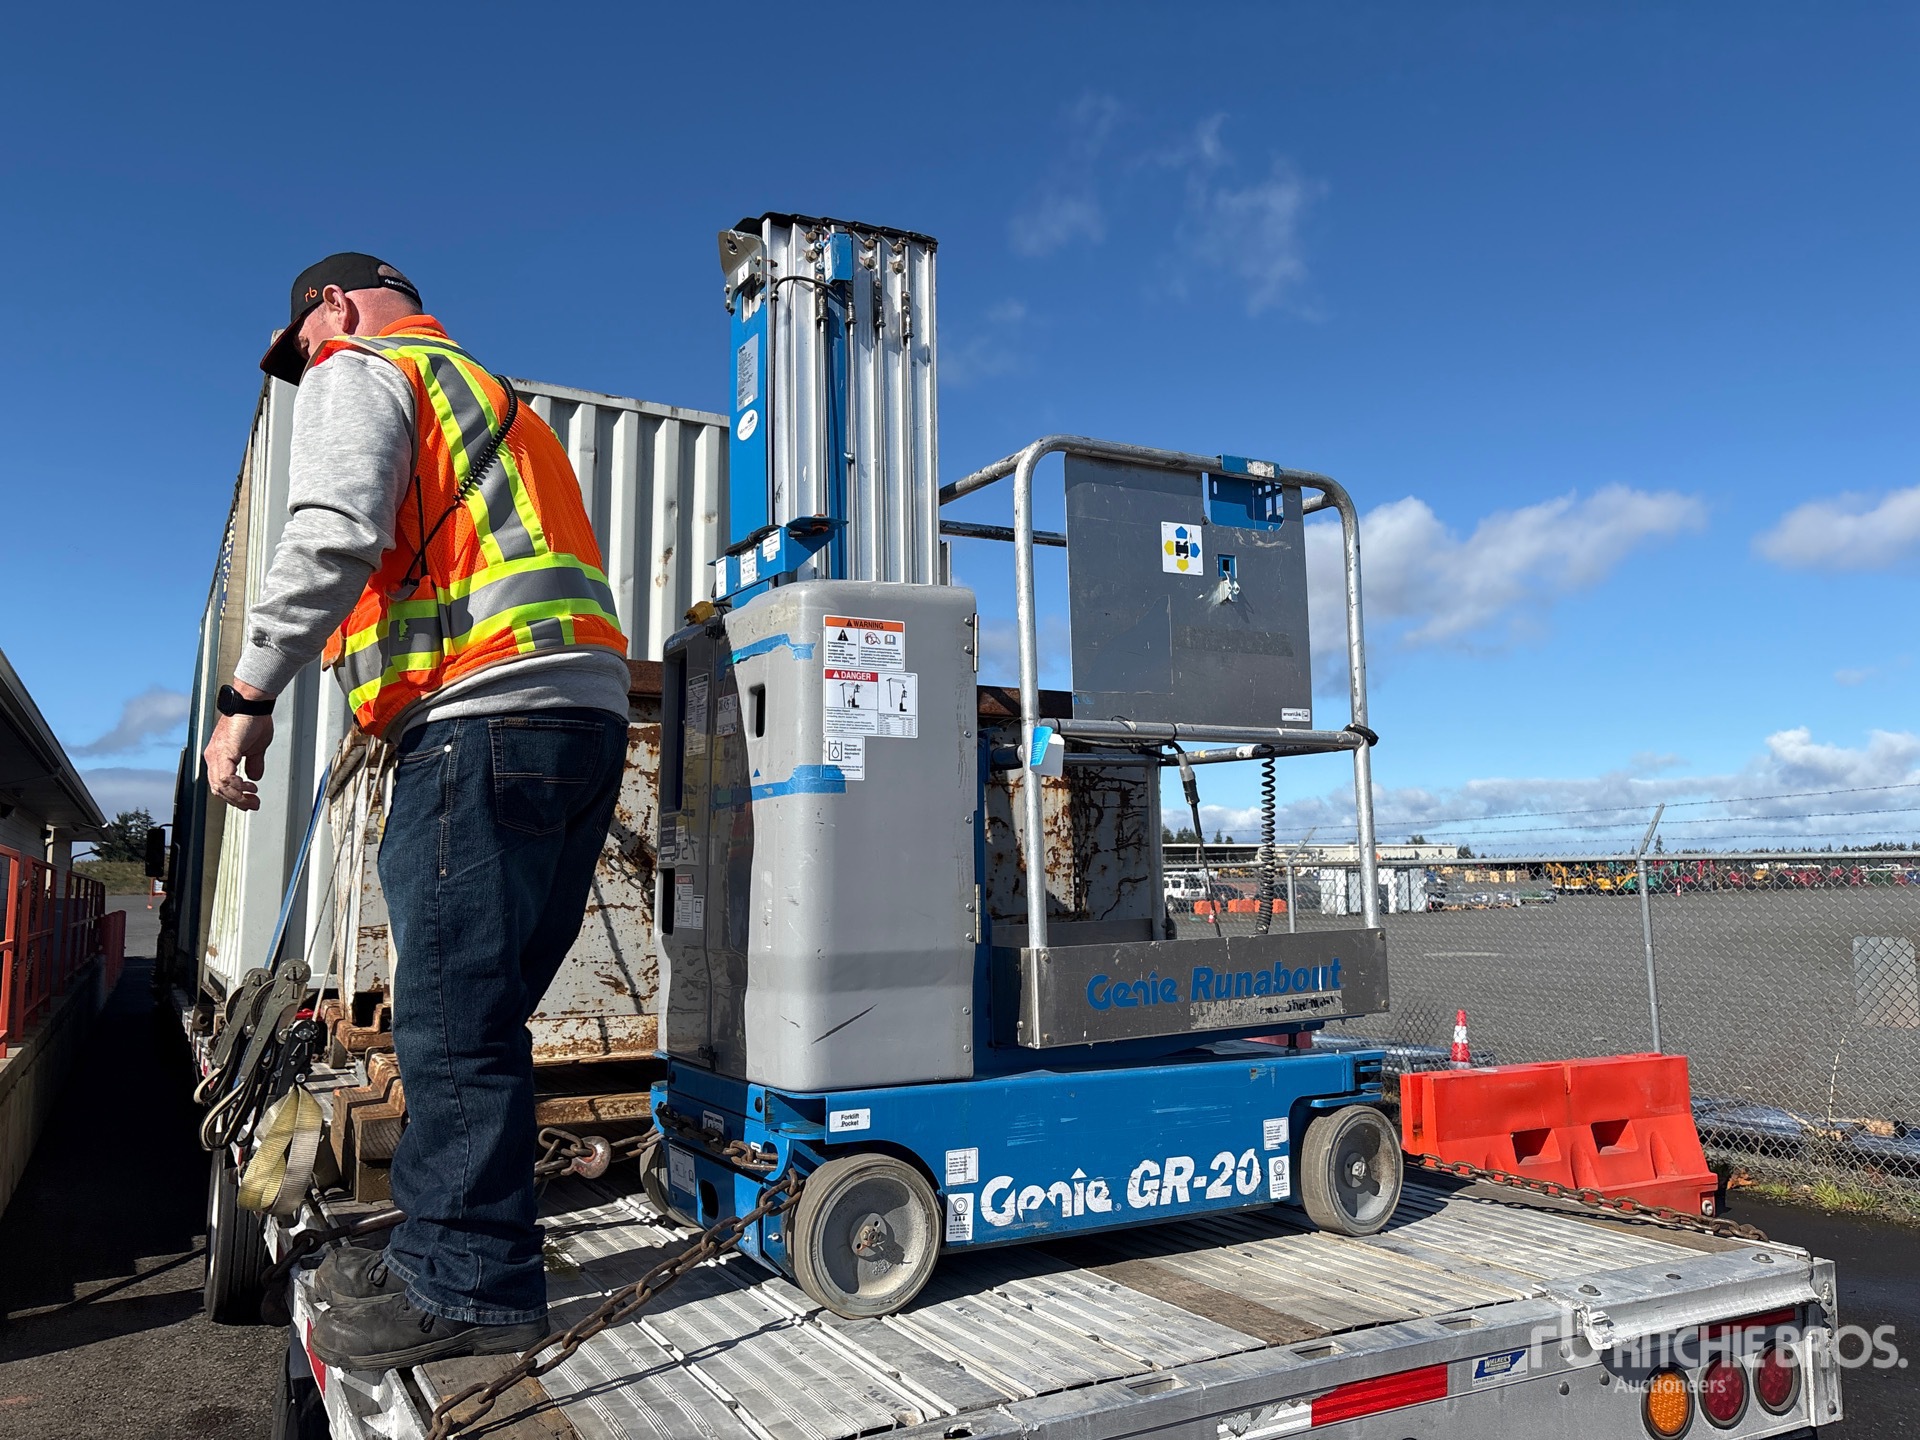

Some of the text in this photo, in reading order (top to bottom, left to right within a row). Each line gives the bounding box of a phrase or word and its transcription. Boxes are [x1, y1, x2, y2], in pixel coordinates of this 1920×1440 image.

[304, 287, 318, 302] rb
[853, 621, 884, 630] WARNING
[840, 671, 872, 681] DANGER
[1191, 957, 1342, 1002] Runabout
[1127, 1148, 1262, 1209] GR-20
